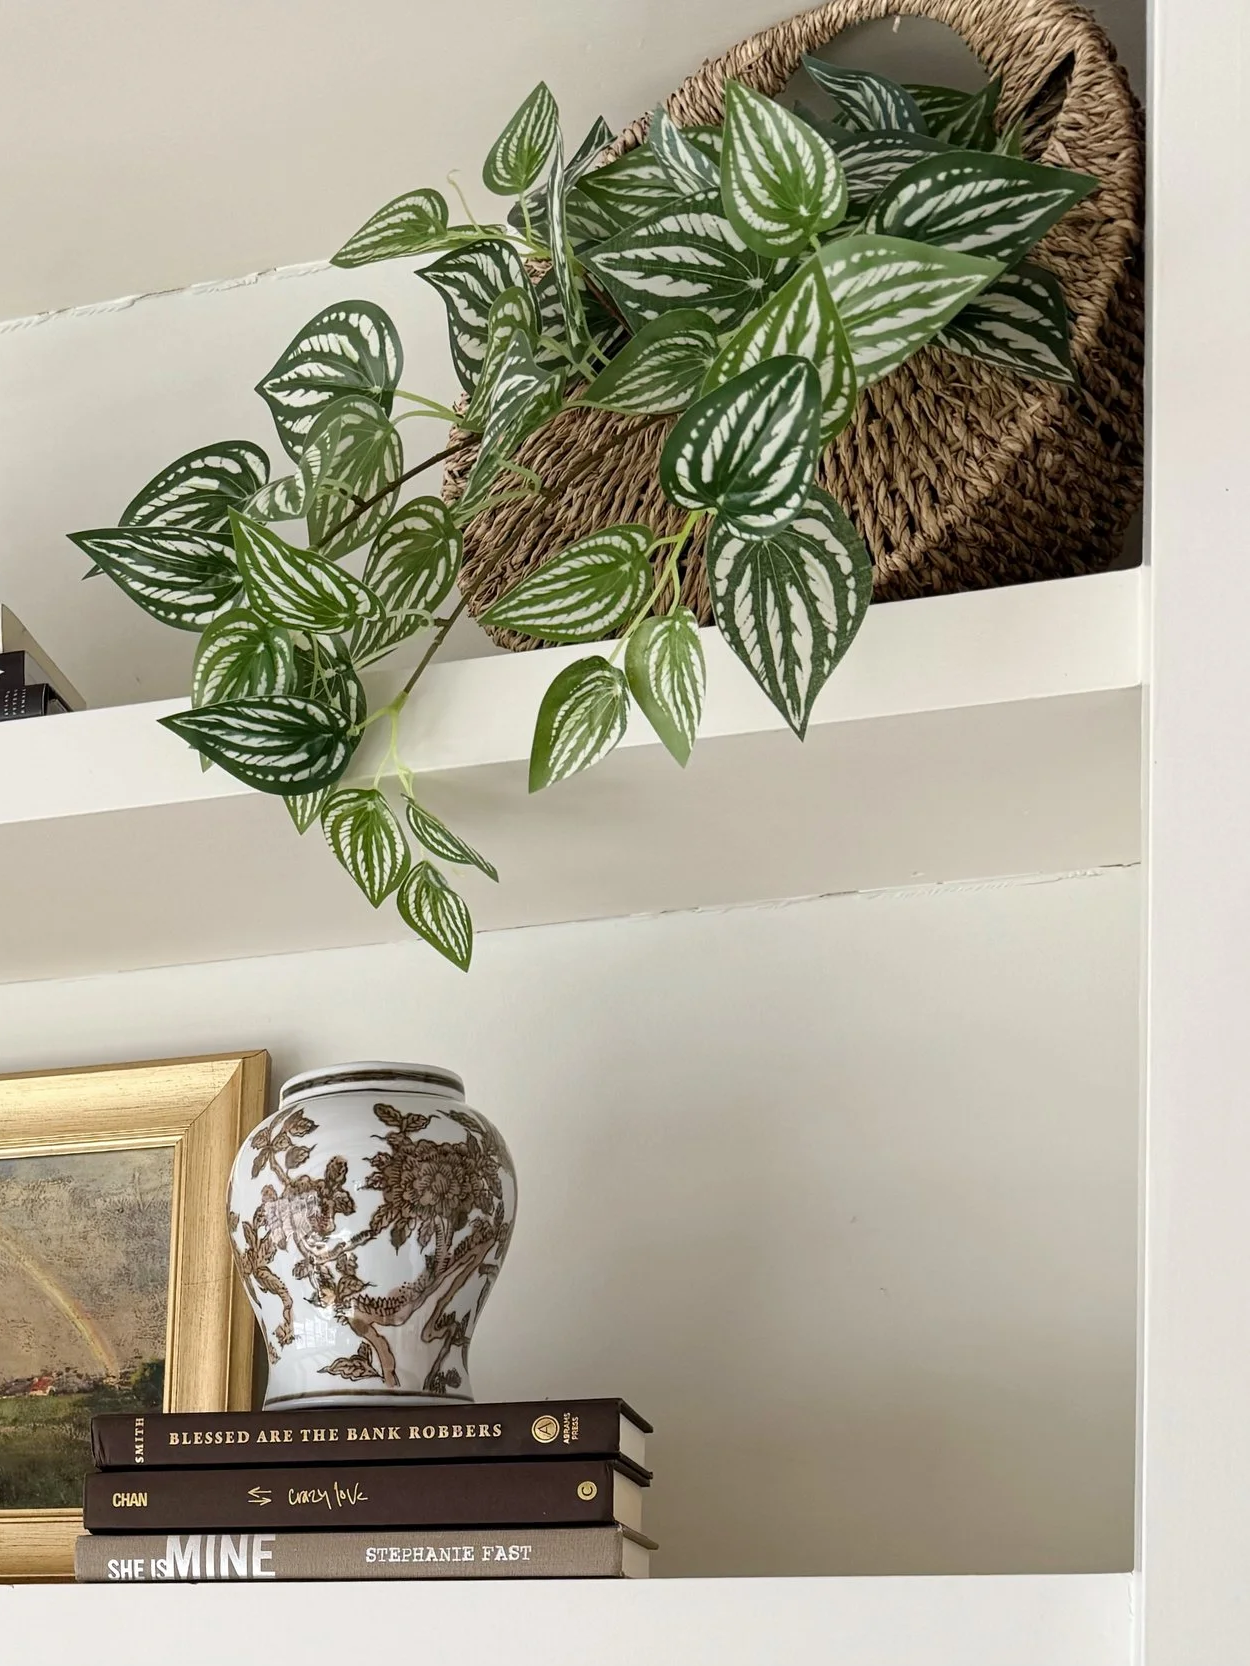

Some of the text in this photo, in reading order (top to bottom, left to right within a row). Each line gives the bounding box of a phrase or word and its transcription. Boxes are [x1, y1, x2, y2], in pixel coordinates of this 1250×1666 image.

[135, 1418, 145, 1464] SMITH
[169, 1423, 502, 1446] BLESSED ARE THE BANK ROBBERS
[563, 1412, 571, 1445] ABRAMS
[112, 1492, 148, 1508] CHAN
[288, 1481, 369, 1510] crazy love
[107, 1534, 276, 1580] SHE IS MINE
[365, 1545, 532, 1563] STEPHANIE FAST
